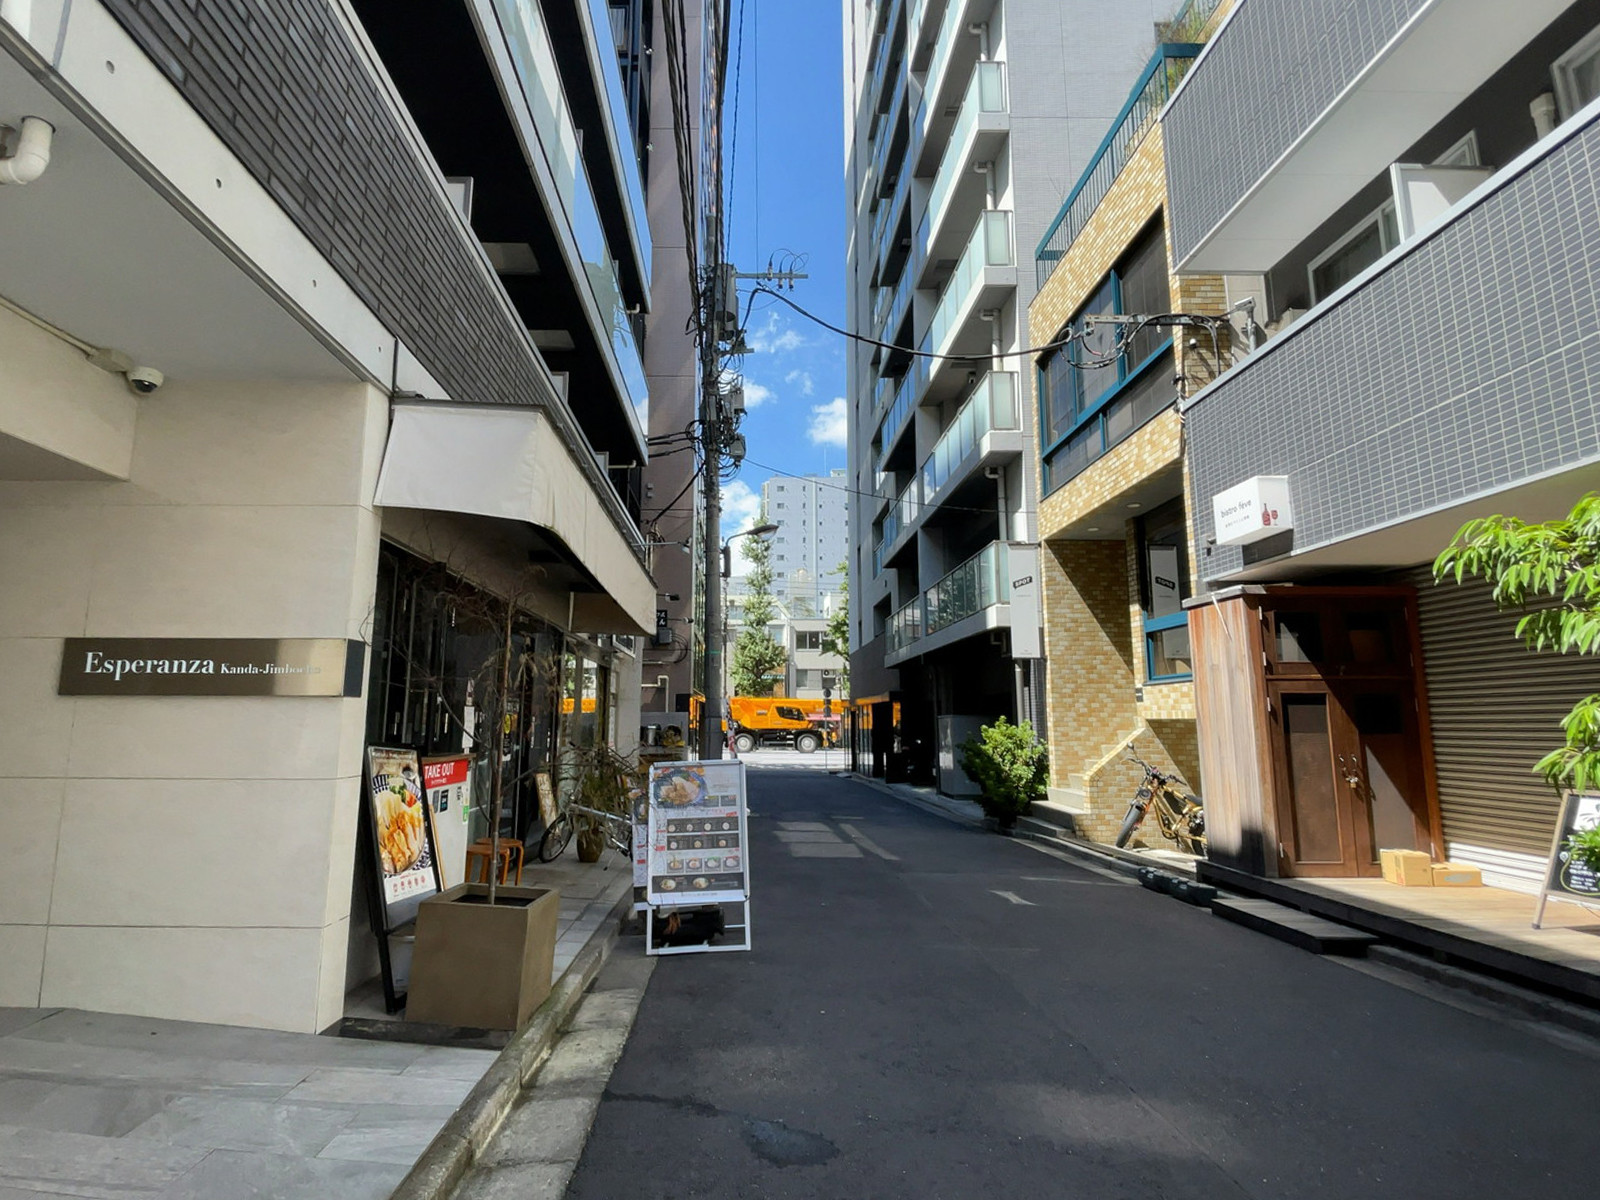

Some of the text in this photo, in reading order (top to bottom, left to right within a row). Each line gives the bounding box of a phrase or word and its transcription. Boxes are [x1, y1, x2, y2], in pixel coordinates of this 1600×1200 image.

[84, 651, 215, 681] Esperanza
[424, 761, 456, 779] TAKE OUT
